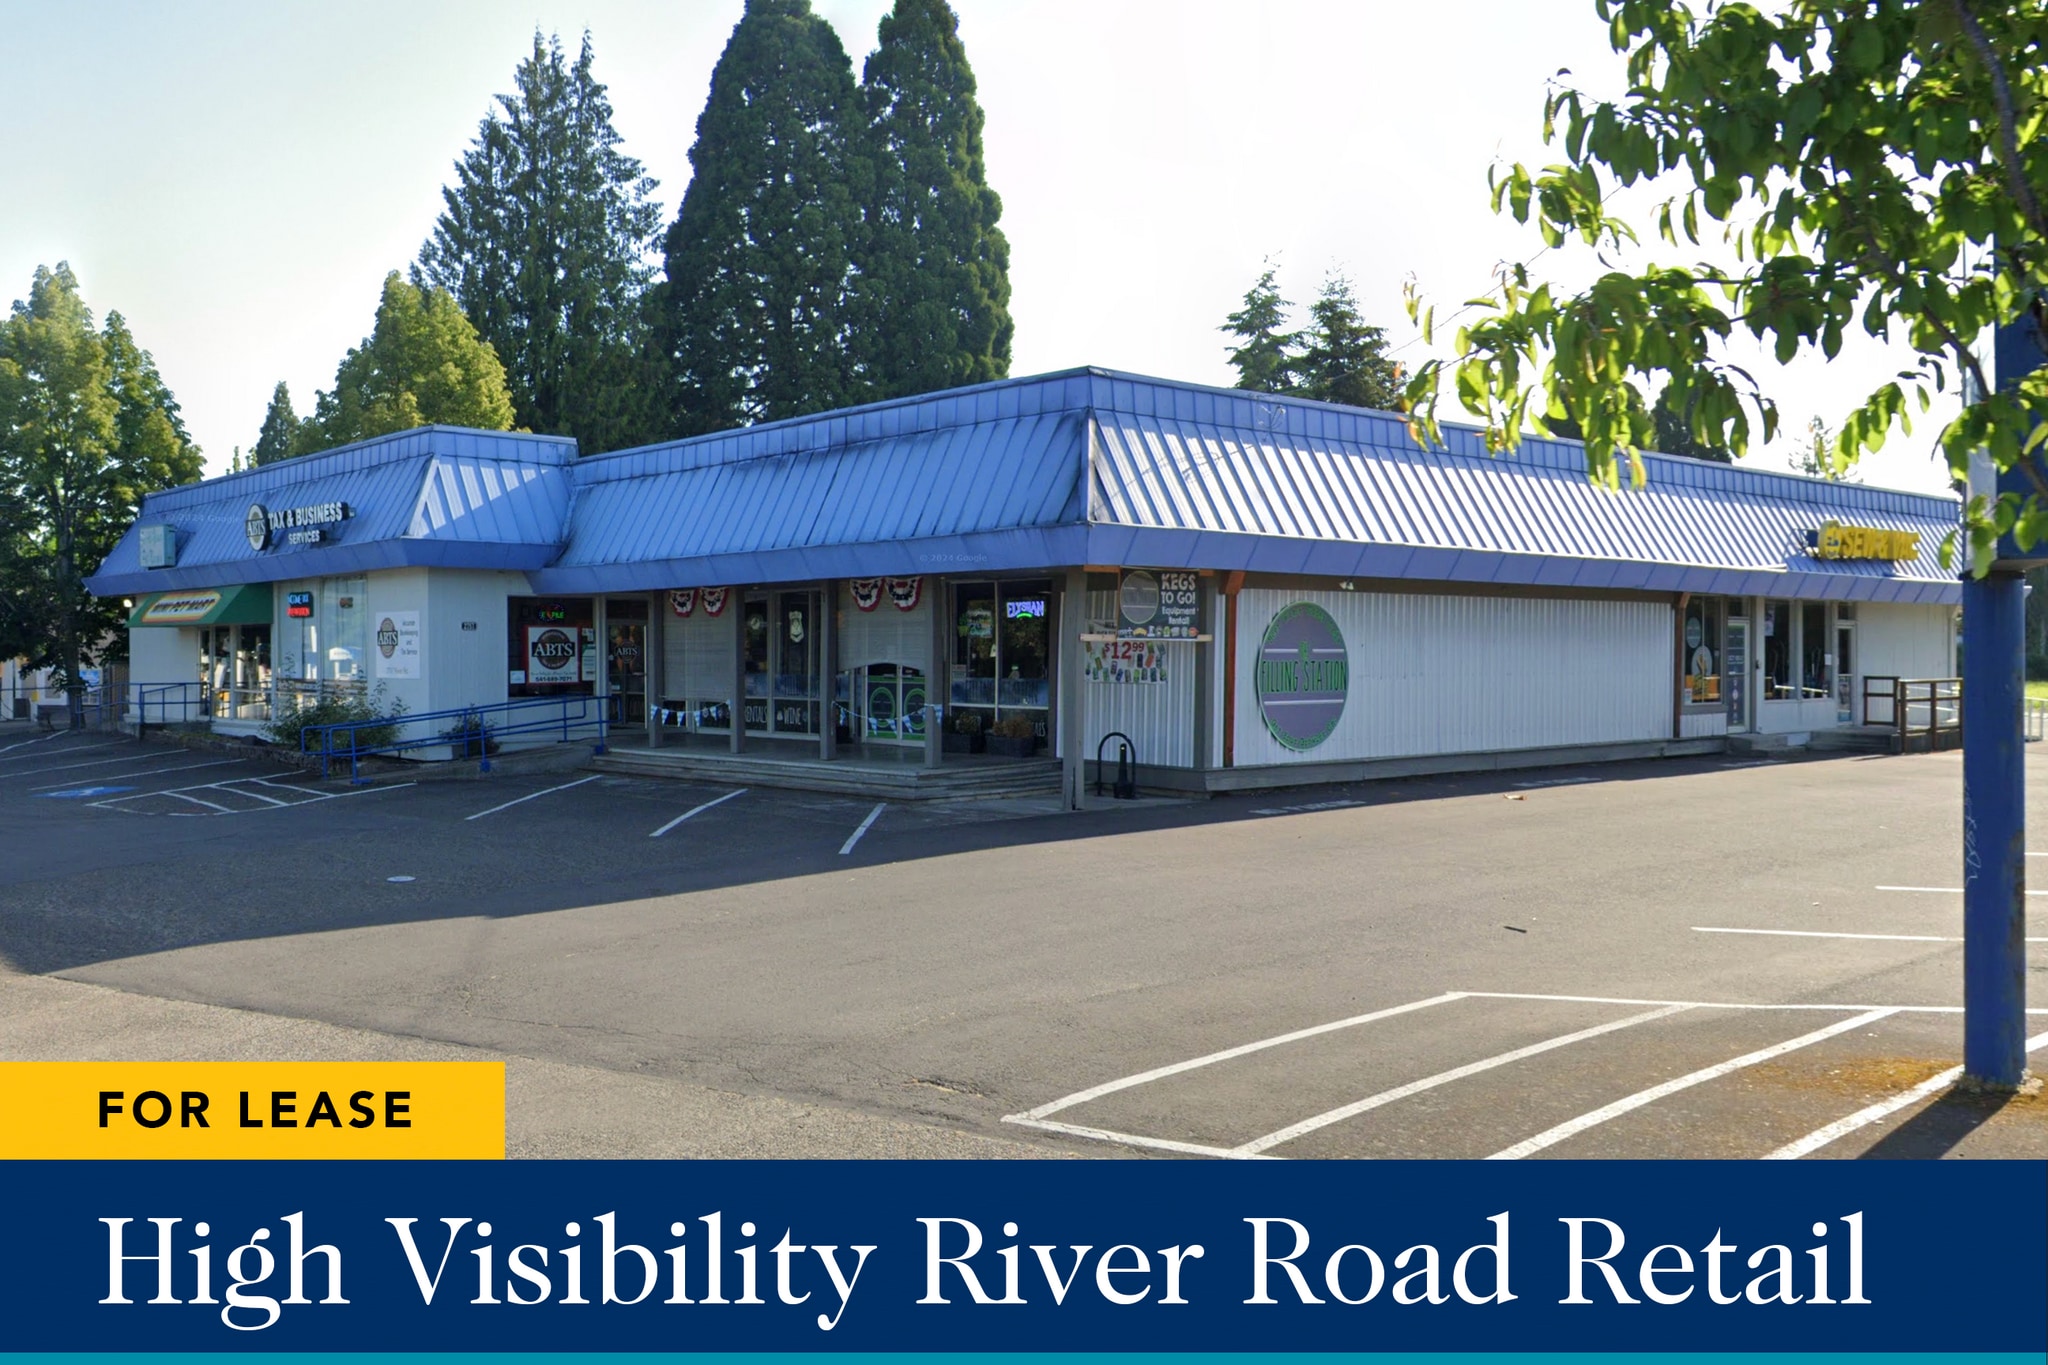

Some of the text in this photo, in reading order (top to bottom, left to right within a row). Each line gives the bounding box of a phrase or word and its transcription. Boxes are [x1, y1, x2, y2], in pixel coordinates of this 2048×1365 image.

[268, 502, 343, 530] TAX & BUSINESS
[246, 520, 266, 537] ABTS
[288, 529, 320, 545] SERVICES
[1161, 573, 1196, 590] KEGS
[1160, 591, 1196, 604] TO GO!
[1007, 601, 1044, 618] ELYSIAN
[1161, 606, 1196, 615] Equipment
[378, 631, 397, 646] ABTS
[533, 642, 573, 657] ABTS
[616, 647, 638, 656] ABTS
[1261, 660, 1347, 693] FILLING STATION
